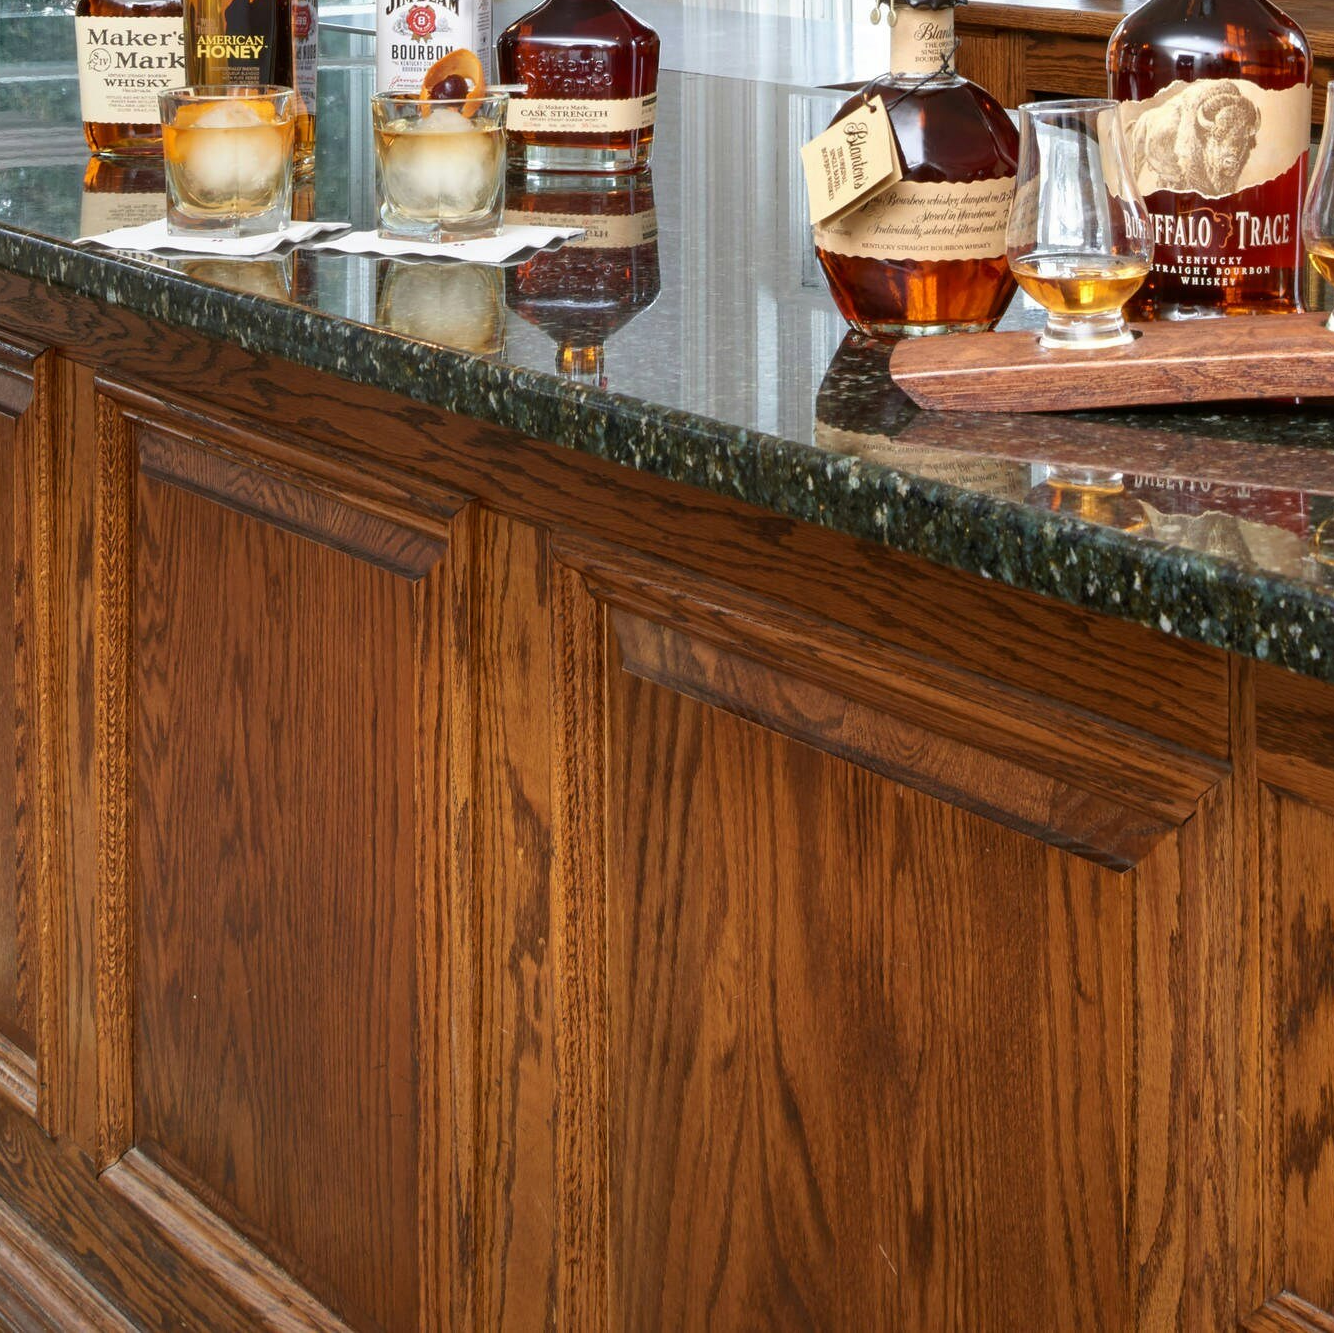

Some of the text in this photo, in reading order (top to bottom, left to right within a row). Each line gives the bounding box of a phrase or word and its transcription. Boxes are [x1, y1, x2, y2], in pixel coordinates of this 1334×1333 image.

[87, 28, 185, 47] Maker's
[196, 35, 265, 46] AMERICAN
[197, 45, 263, 59] HONEY
[115, 52, 185, 69] Mark
[103, 78, 171, 88] WHISKY
[551, 110, 608, 118] STRENGTH
[844, 122, 868, 189] Blanton's
[887, 193, 925, 206] Bourbon
[1236, 211, 1290, 250] TRACE
[861, 242, 895, 250] KENTUCKY
[965, 242, 992, 250] WHISKEY
[1177, 255, 1242, 265] KENTUCKY
[1150, 263, 1270, 275] STRAIGHT BOURBON
[1181, 276, 1236, 286] WHISKEY
